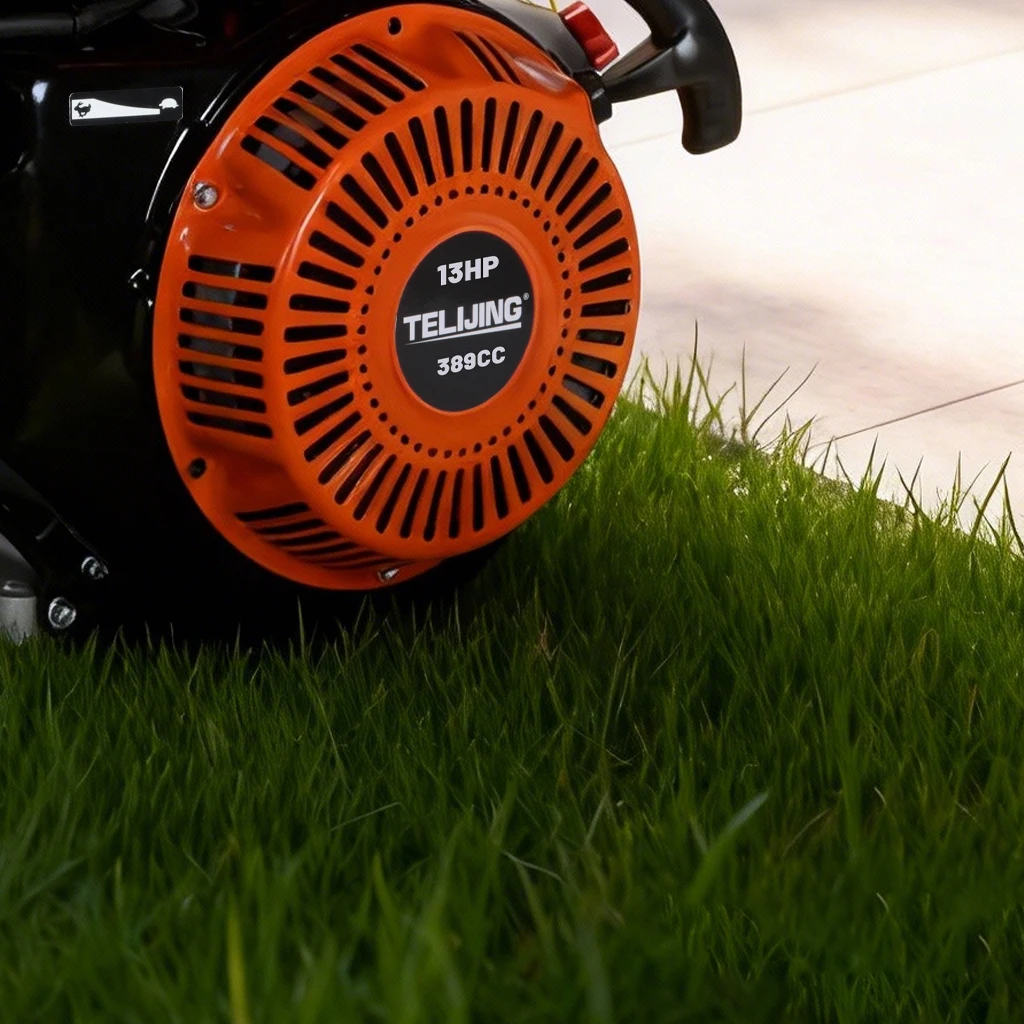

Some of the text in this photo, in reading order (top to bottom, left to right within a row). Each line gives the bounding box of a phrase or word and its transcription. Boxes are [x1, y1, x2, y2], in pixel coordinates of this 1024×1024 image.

[437, 256, 500, 286] 13HP
[403, 296, 522, 341] TELIJING
[437, 346, 506, 376] 389CC
